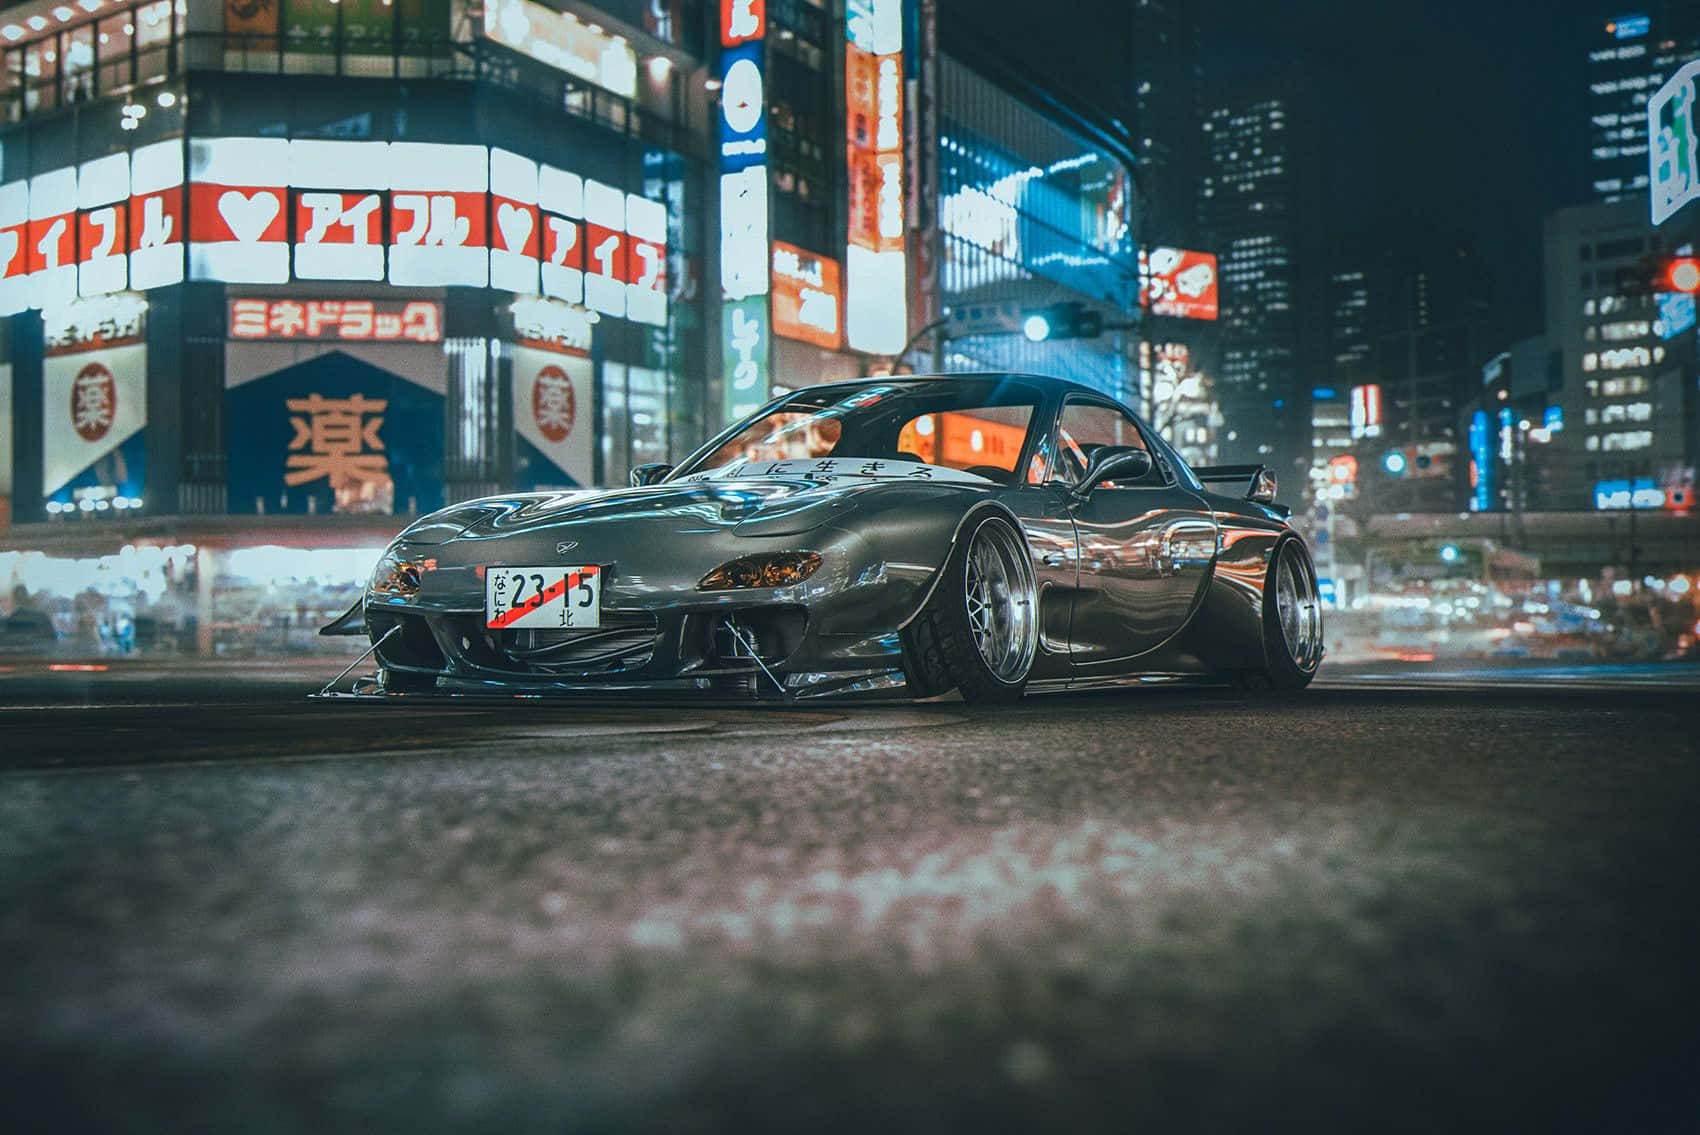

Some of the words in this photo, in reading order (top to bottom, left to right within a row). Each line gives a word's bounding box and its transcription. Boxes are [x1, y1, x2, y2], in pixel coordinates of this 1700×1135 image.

[300, 193, 471, 246] アイフル
[284, 393, 391, 489] 薬
[494, 573, 506, 624] なにわ
[559, 608, 574, 627] 北
